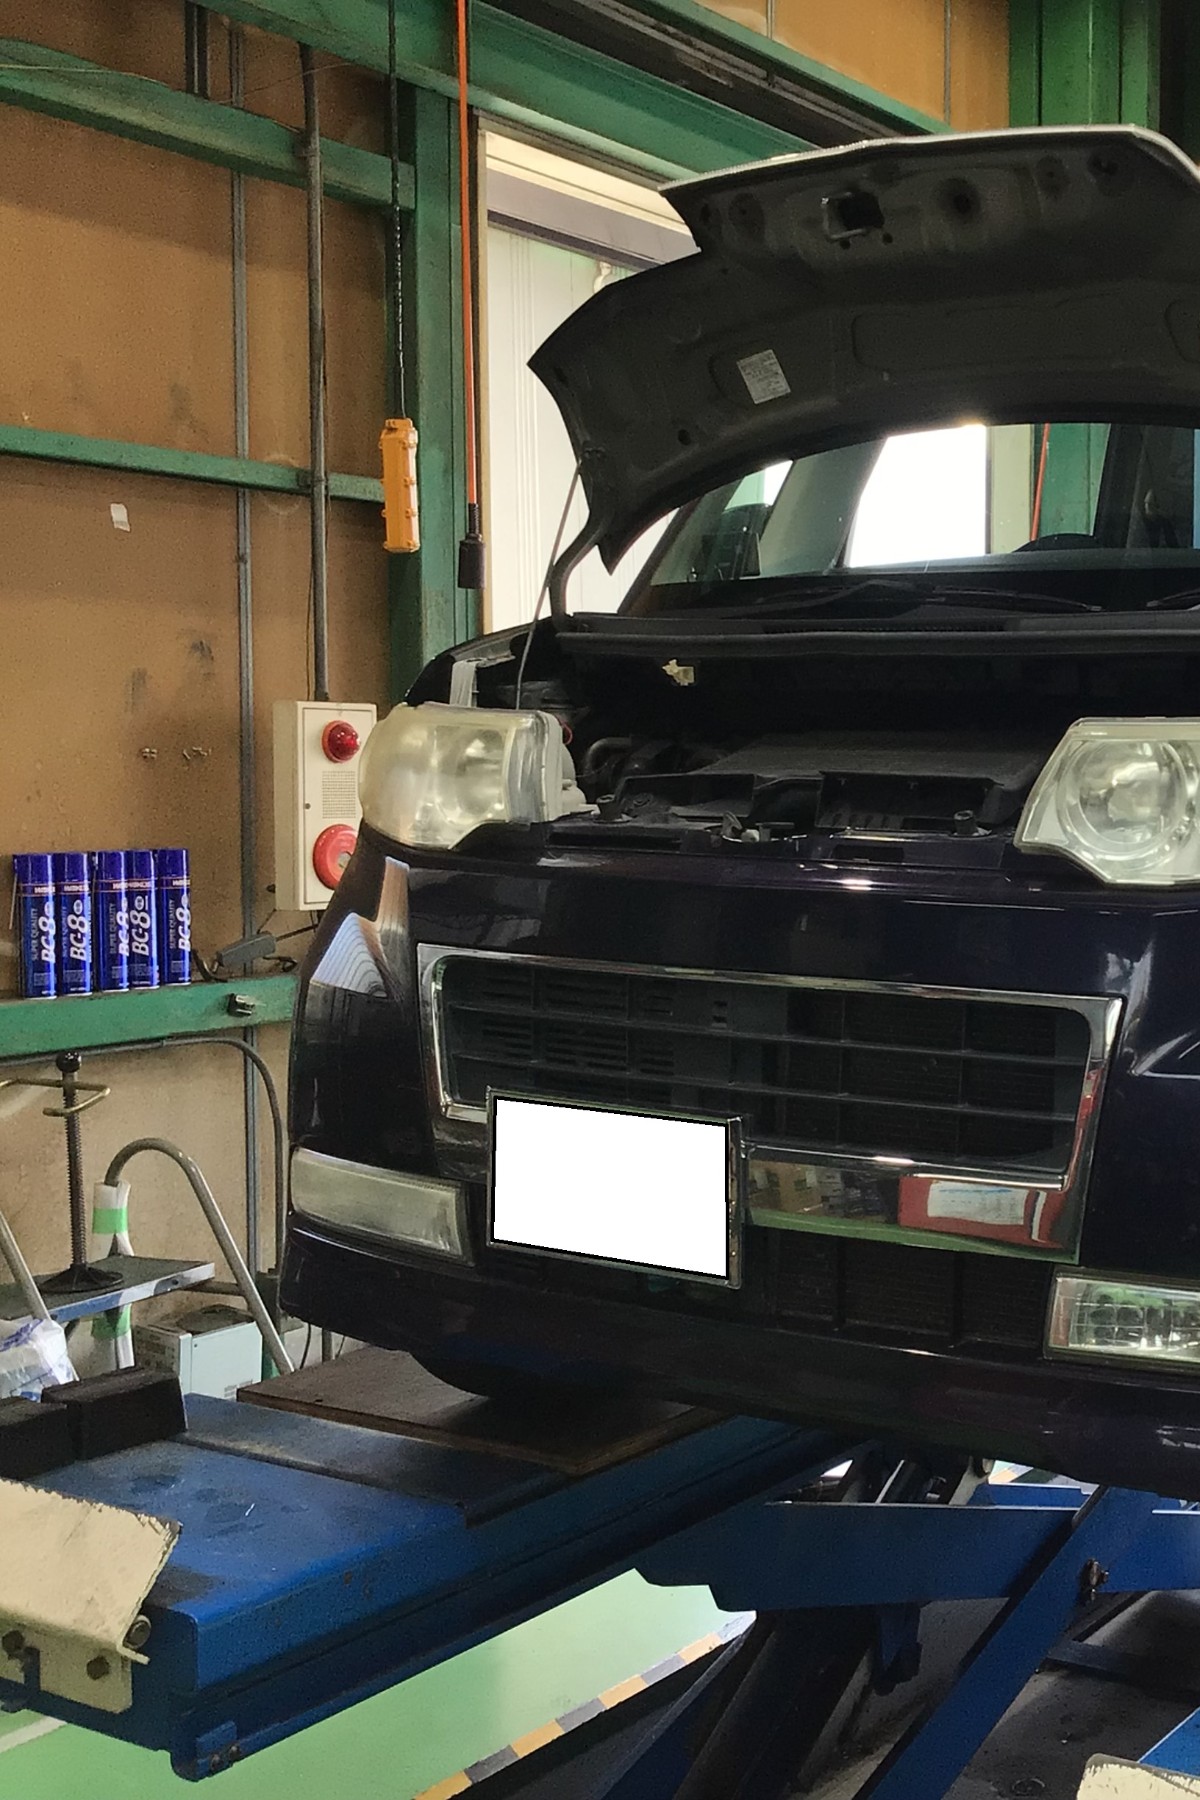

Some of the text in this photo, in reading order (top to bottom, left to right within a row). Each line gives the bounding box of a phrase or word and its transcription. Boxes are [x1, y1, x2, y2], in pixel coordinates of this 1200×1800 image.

[30, 908, 38, 938] QUALITY
[109, 903, 117, 932] QUALITY
[130, 909, 151, 956] BC-8
[168, 899, 176, 928] QUALITY
[175, 907, 191, 952] BC-8
[38, 916, 56, 964] BC-8
[67, 914, 88, 961] BC-8
